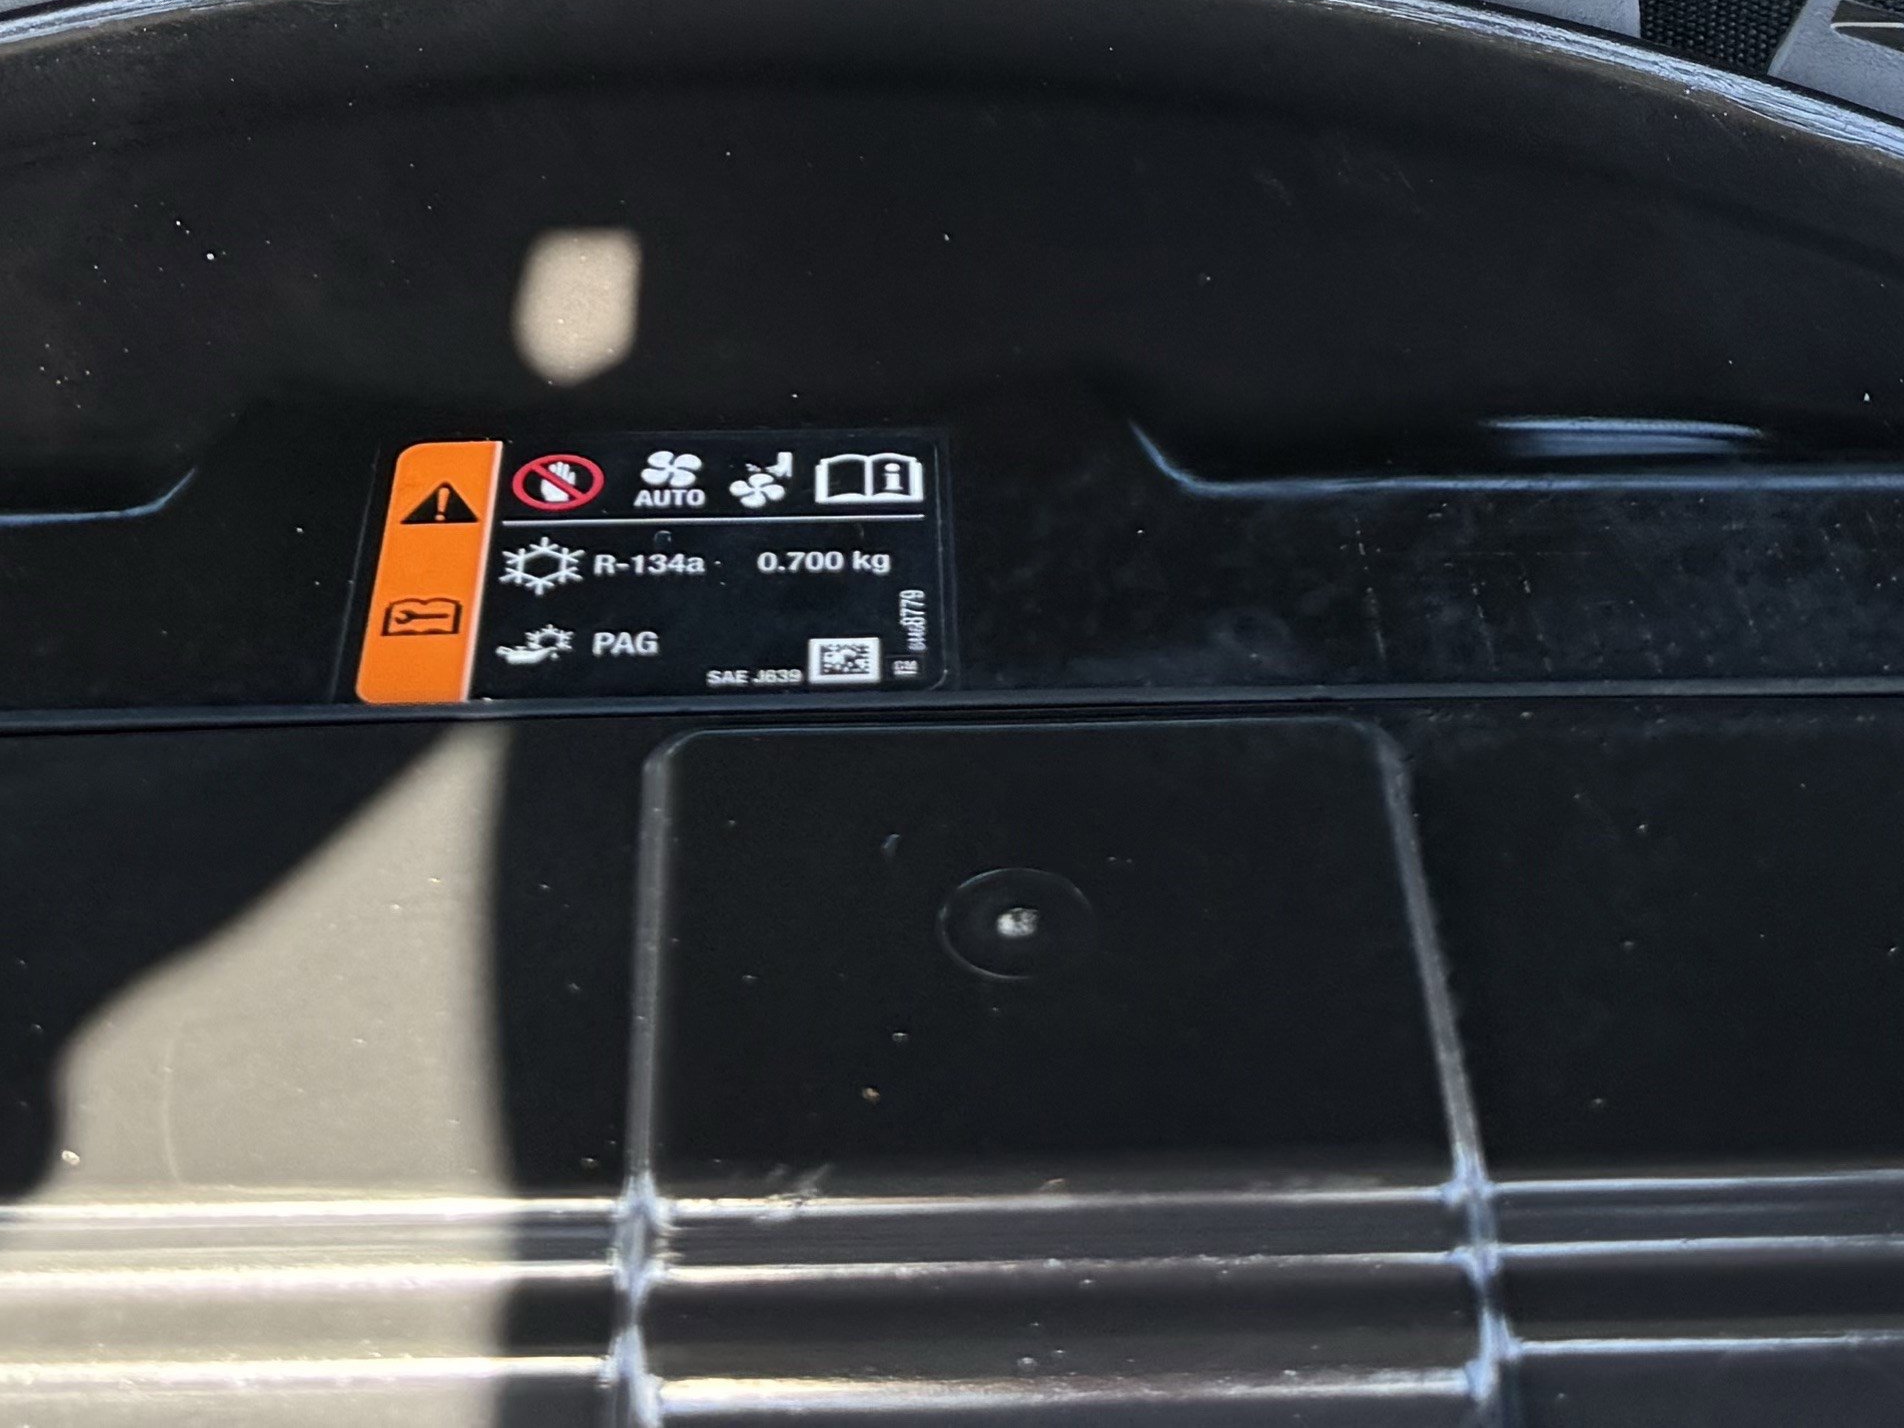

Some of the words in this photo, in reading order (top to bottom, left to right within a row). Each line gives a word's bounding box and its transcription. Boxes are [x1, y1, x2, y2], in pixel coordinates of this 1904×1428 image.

[633, 488, 706, 508] AUTO
[593, 552, 706, 577] R-134a
[756, 550, 845, 573] 0.700
[851, 550, 892, 576] kg
[592, 630, 659, 656] PAG
[706, 669, 749, 686] SAE
[751, 668, 804, 685] J639
